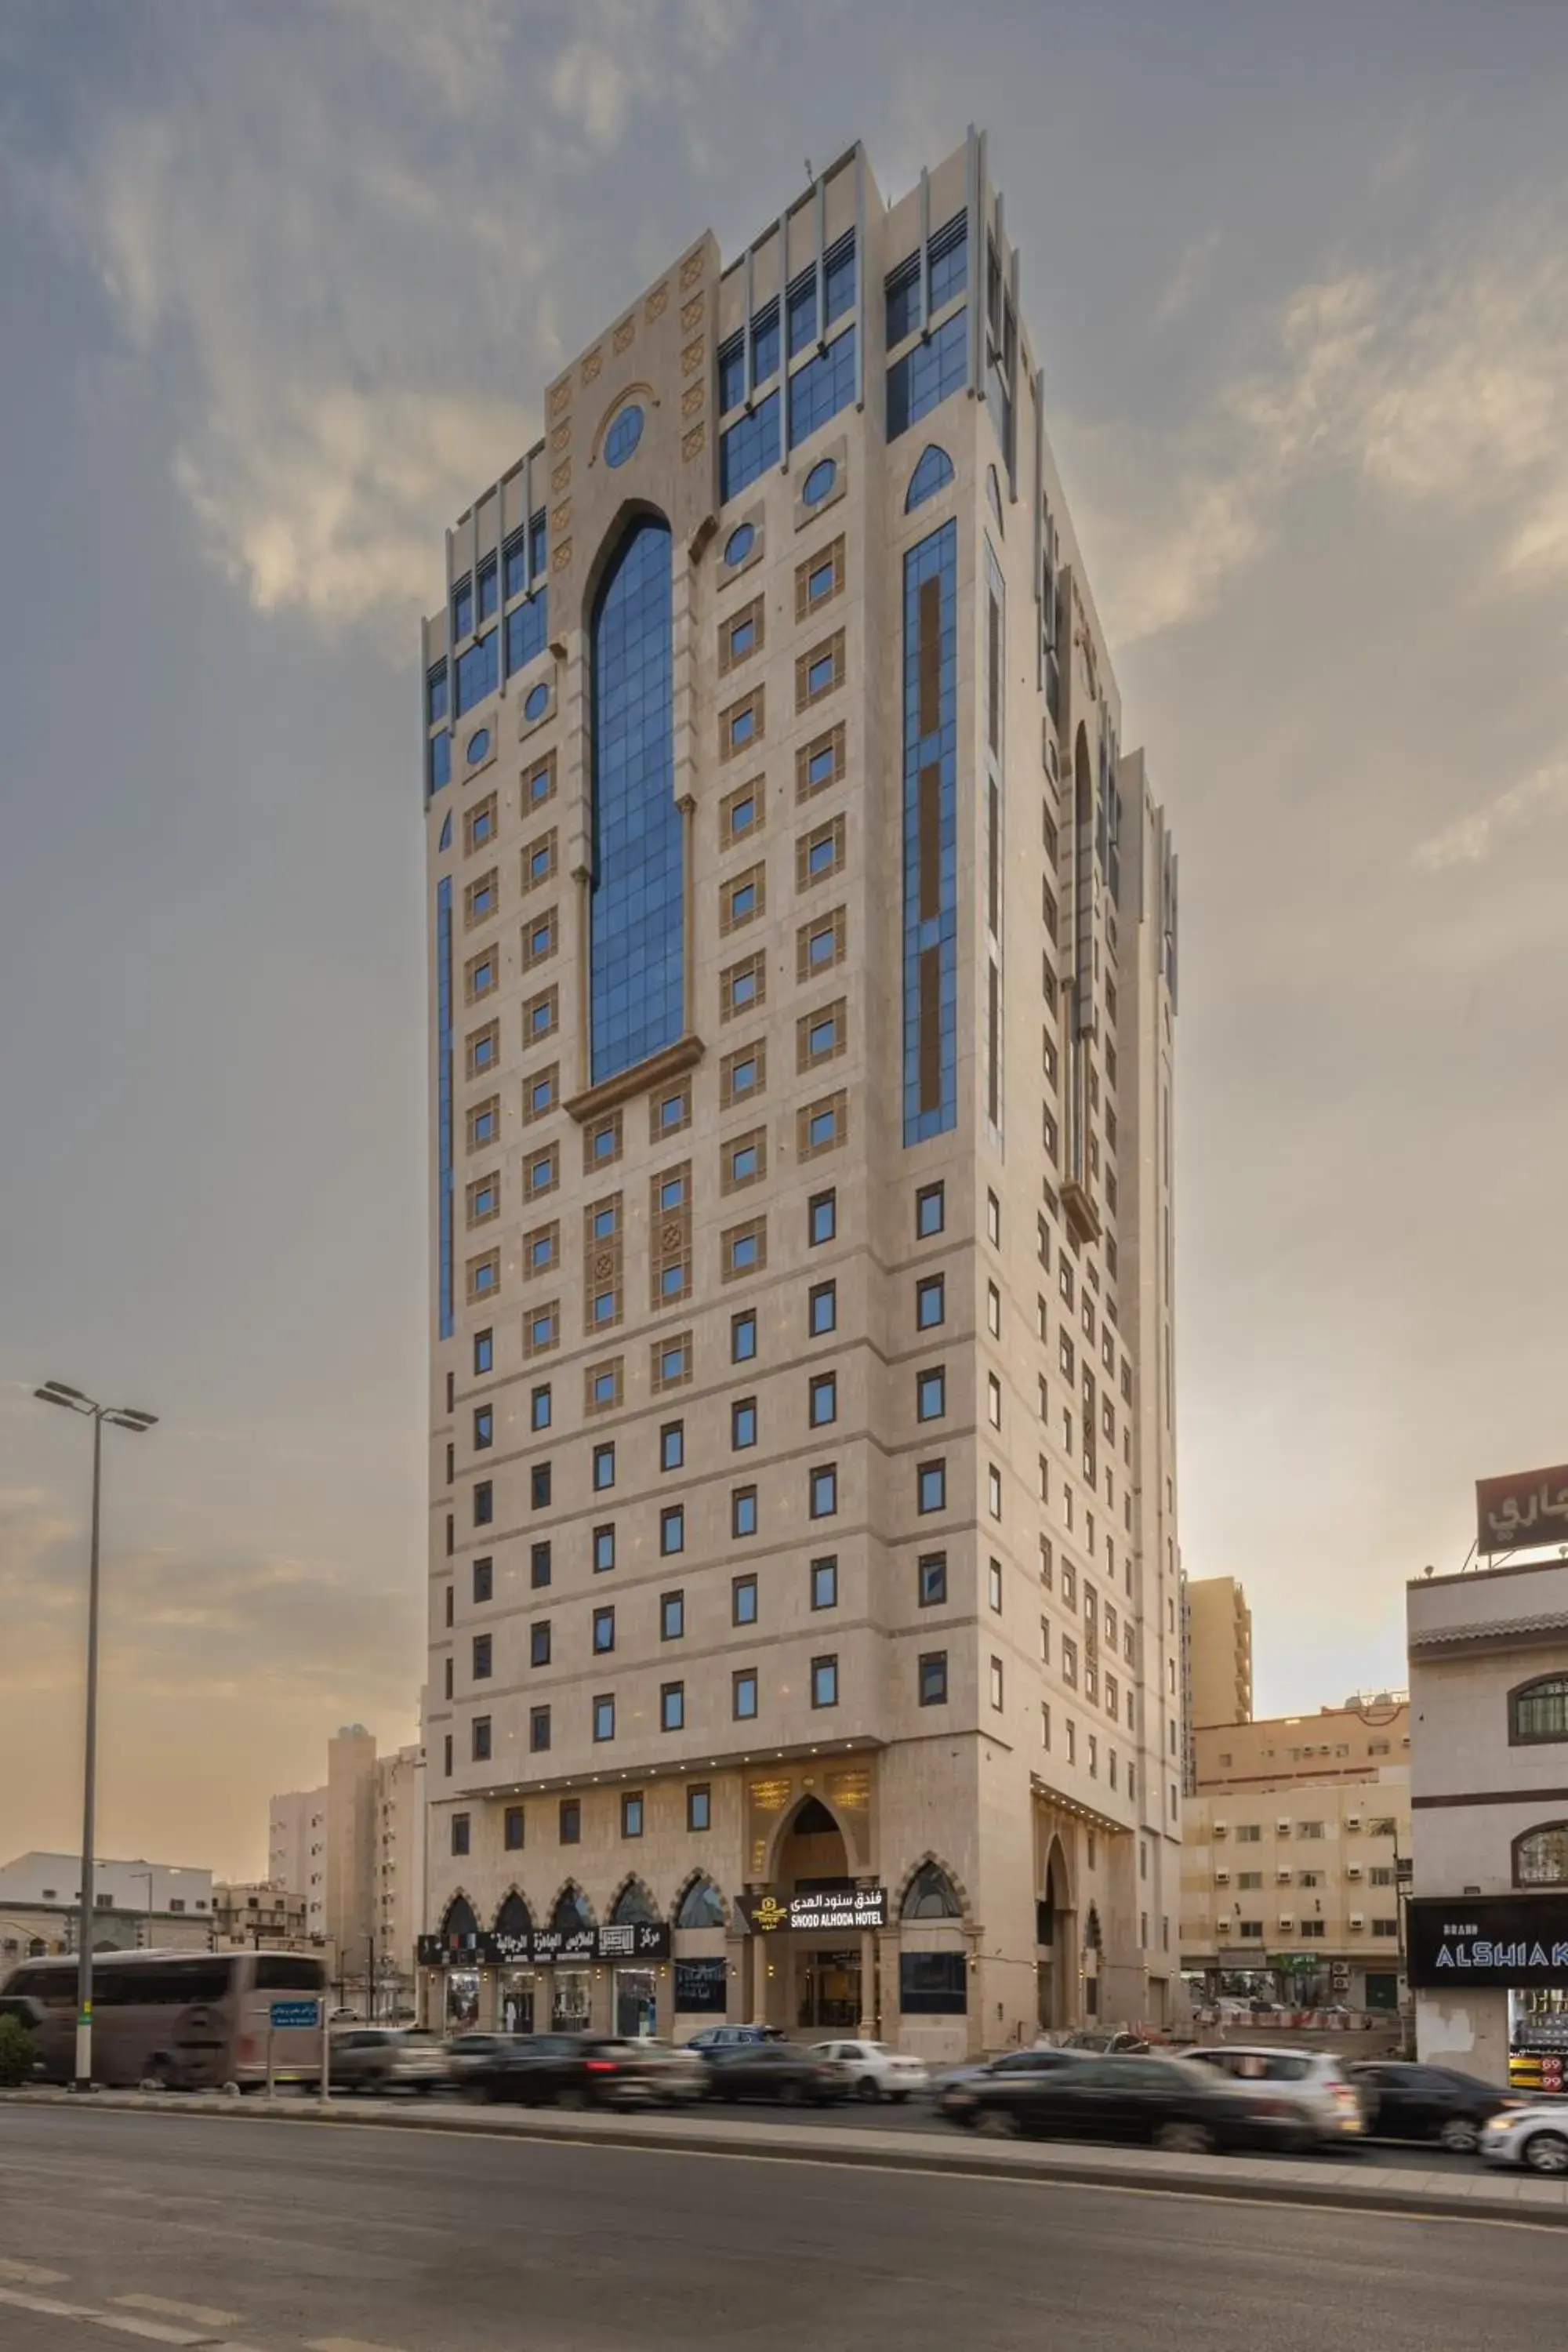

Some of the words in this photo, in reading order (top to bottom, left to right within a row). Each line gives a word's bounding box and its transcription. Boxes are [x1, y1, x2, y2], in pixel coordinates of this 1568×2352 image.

[824, 1894, 852, 1910] سنود
[855, 1890, 883, 1910] فندق
[790, 1914, 819, 1928] SNOOD
[855, 1911, 884, 1926] HOTEL
